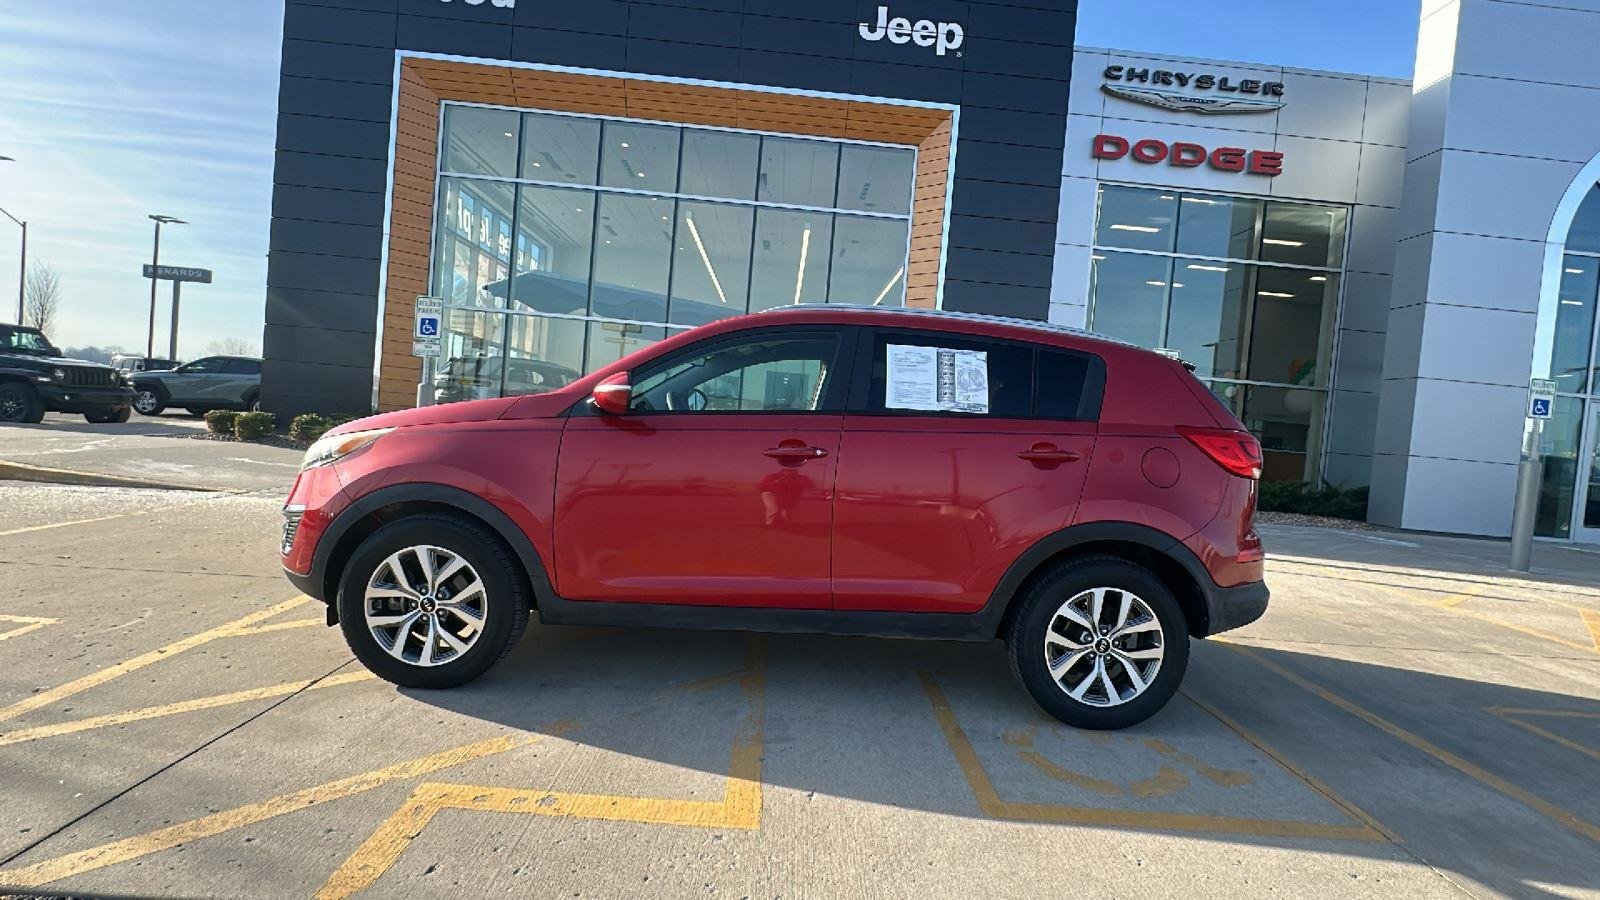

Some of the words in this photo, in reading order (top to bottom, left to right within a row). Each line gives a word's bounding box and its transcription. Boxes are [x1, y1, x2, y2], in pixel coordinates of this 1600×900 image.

[859, 6, 964, 56] Jeep
[1104, 65, 1284, 96] CHRYSLER
[1093, 134, 1284, 176] DODGE
